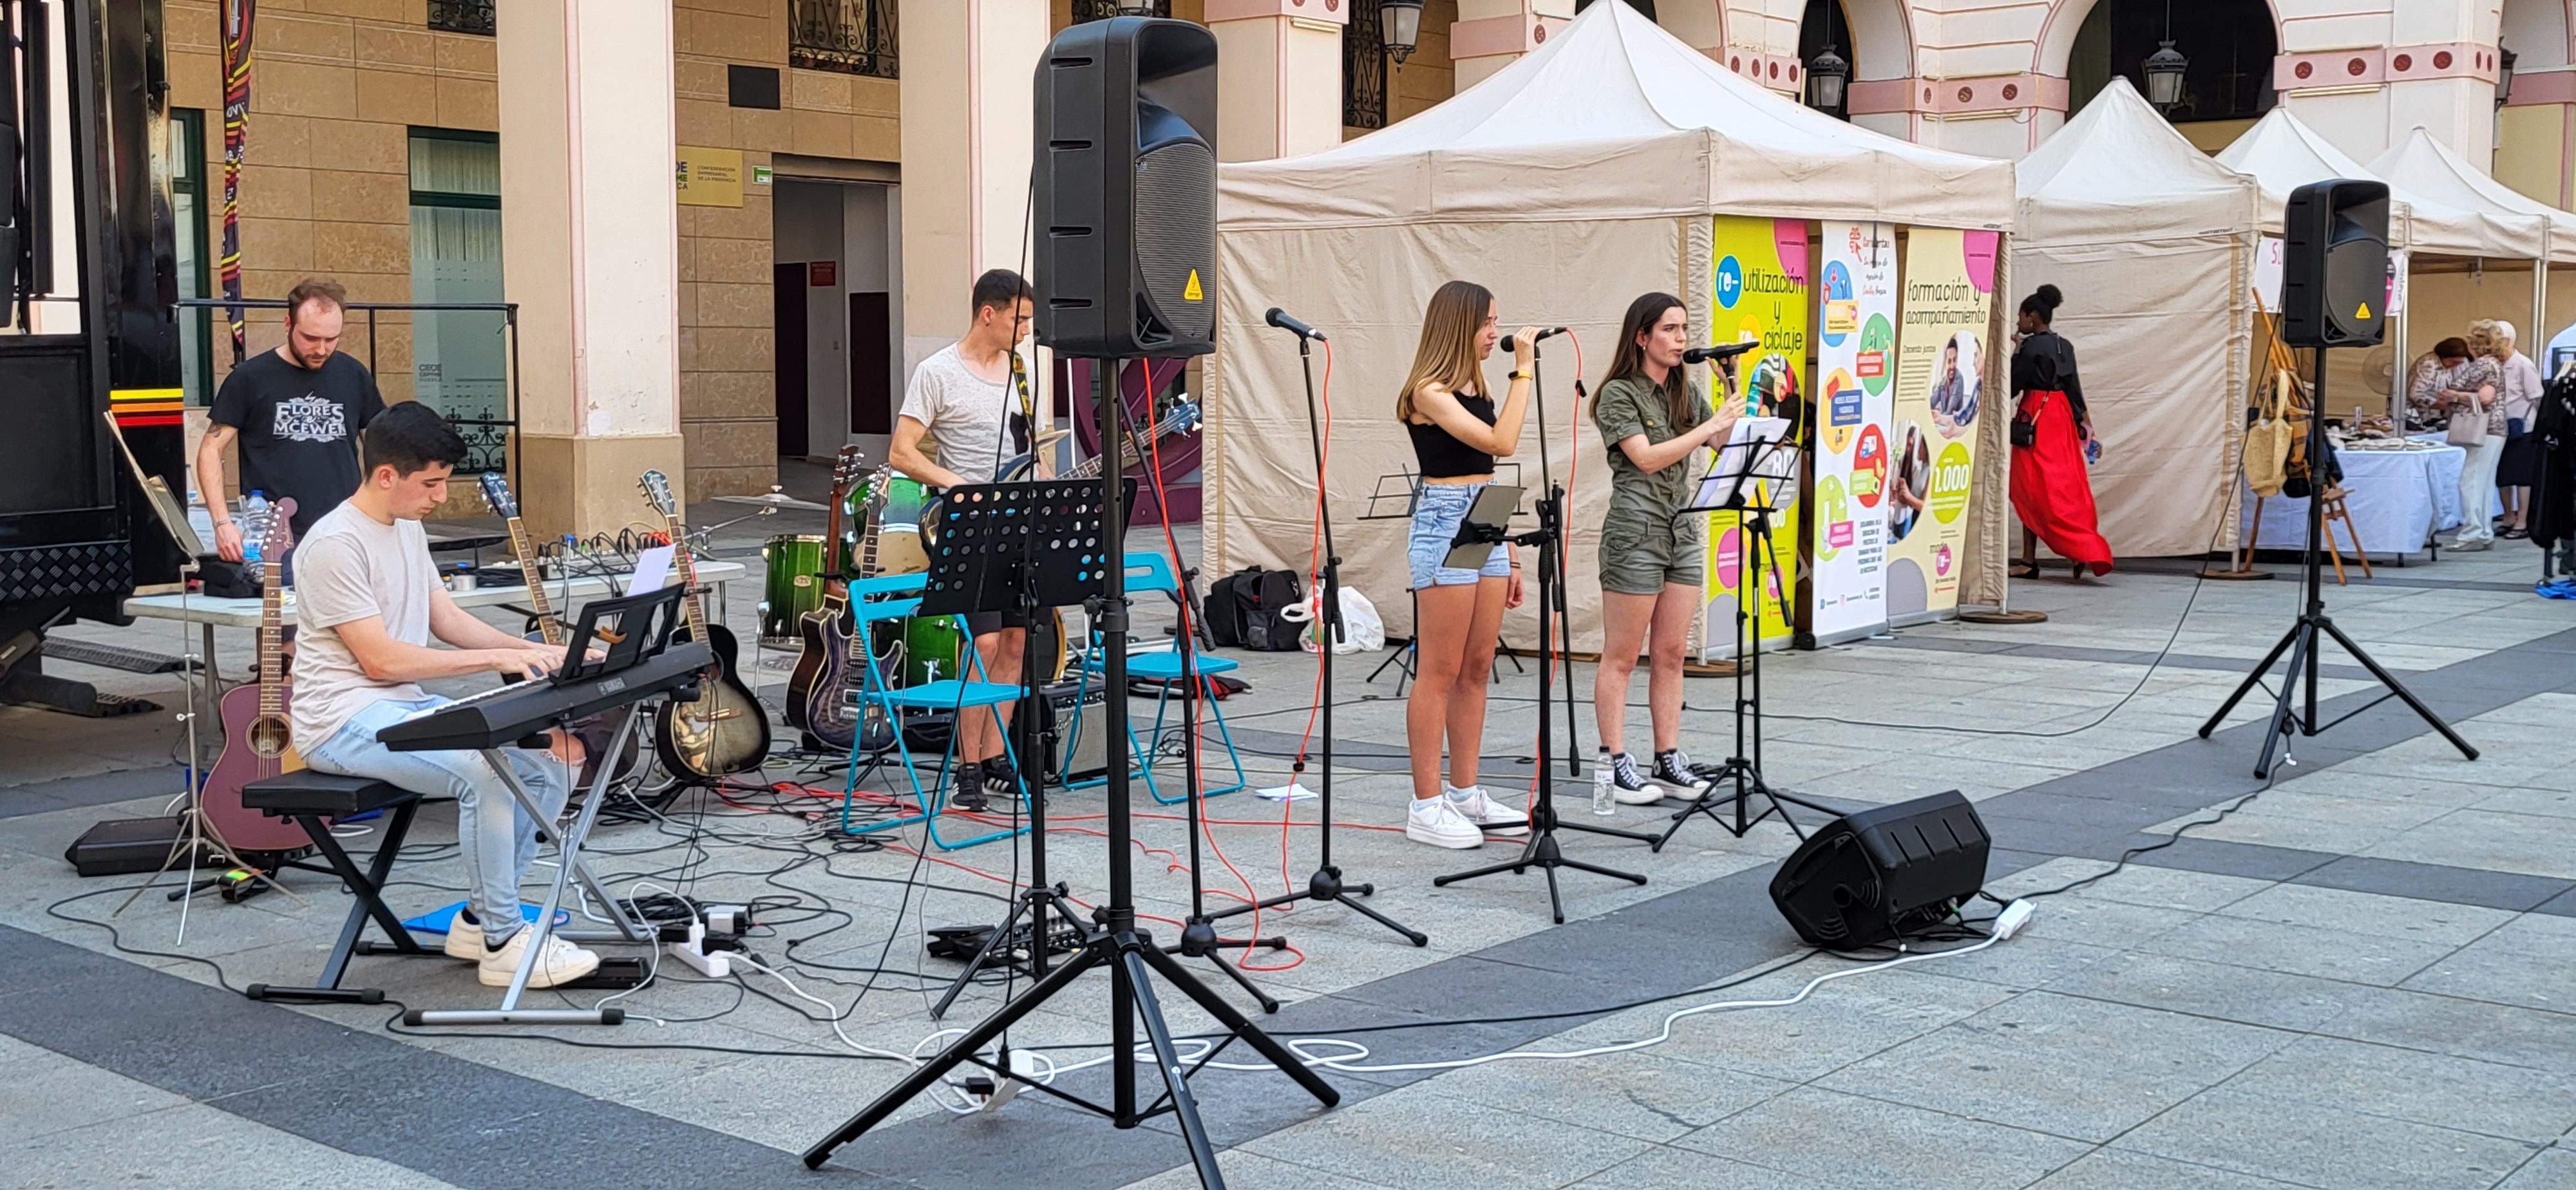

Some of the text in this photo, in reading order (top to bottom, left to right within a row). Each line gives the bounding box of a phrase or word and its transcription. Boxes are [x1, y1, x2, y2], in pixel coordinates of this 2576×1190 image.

[1718, 267, 1804, 294] re- utilización
[1908, 276, 1982, 306] formación y
[1774, 301, 1781, 325] y
[1906, 305, 1986, 328] acompañamiento
[1764, 326, 1803, 355] ciclaje
